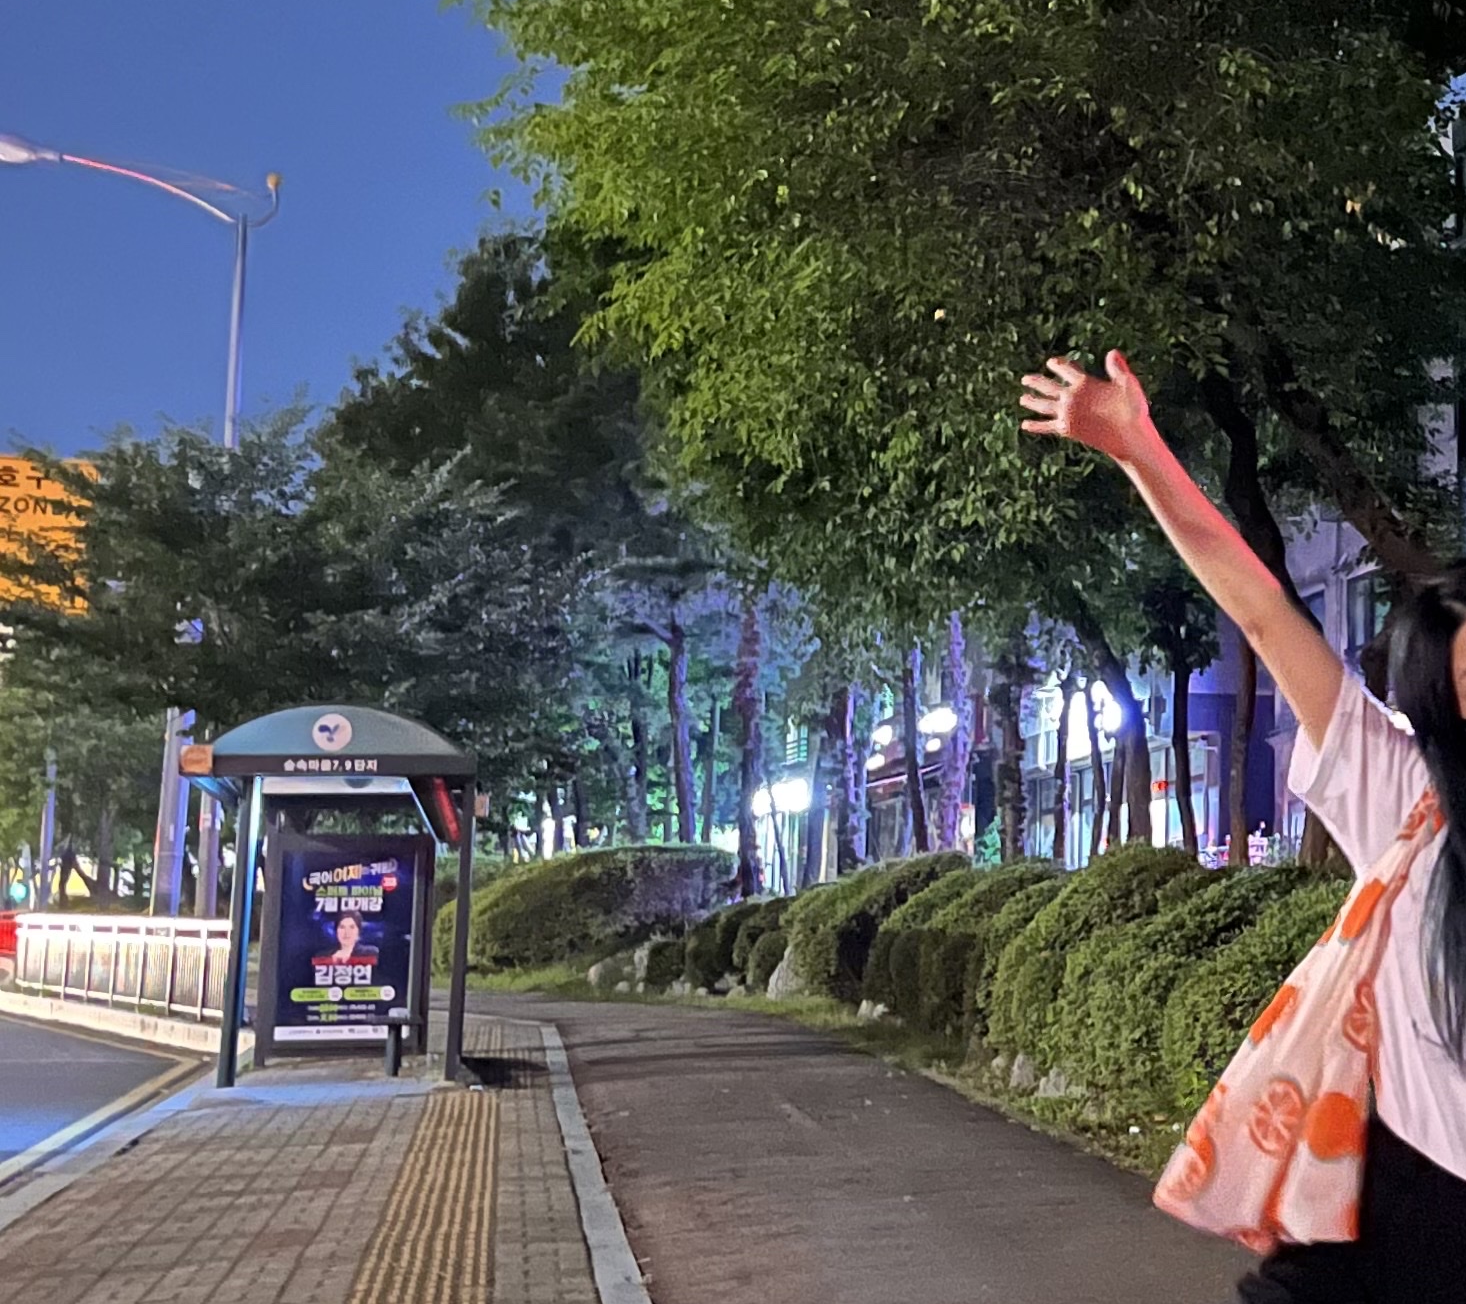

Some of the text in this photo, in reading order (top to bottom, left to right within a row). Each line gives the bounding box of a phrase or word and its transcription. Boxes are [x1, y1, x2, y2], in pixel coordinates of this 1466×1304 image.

[315, 897, 383, 912] 7월 대개강
[315, 965, 372, 985] 김정연
